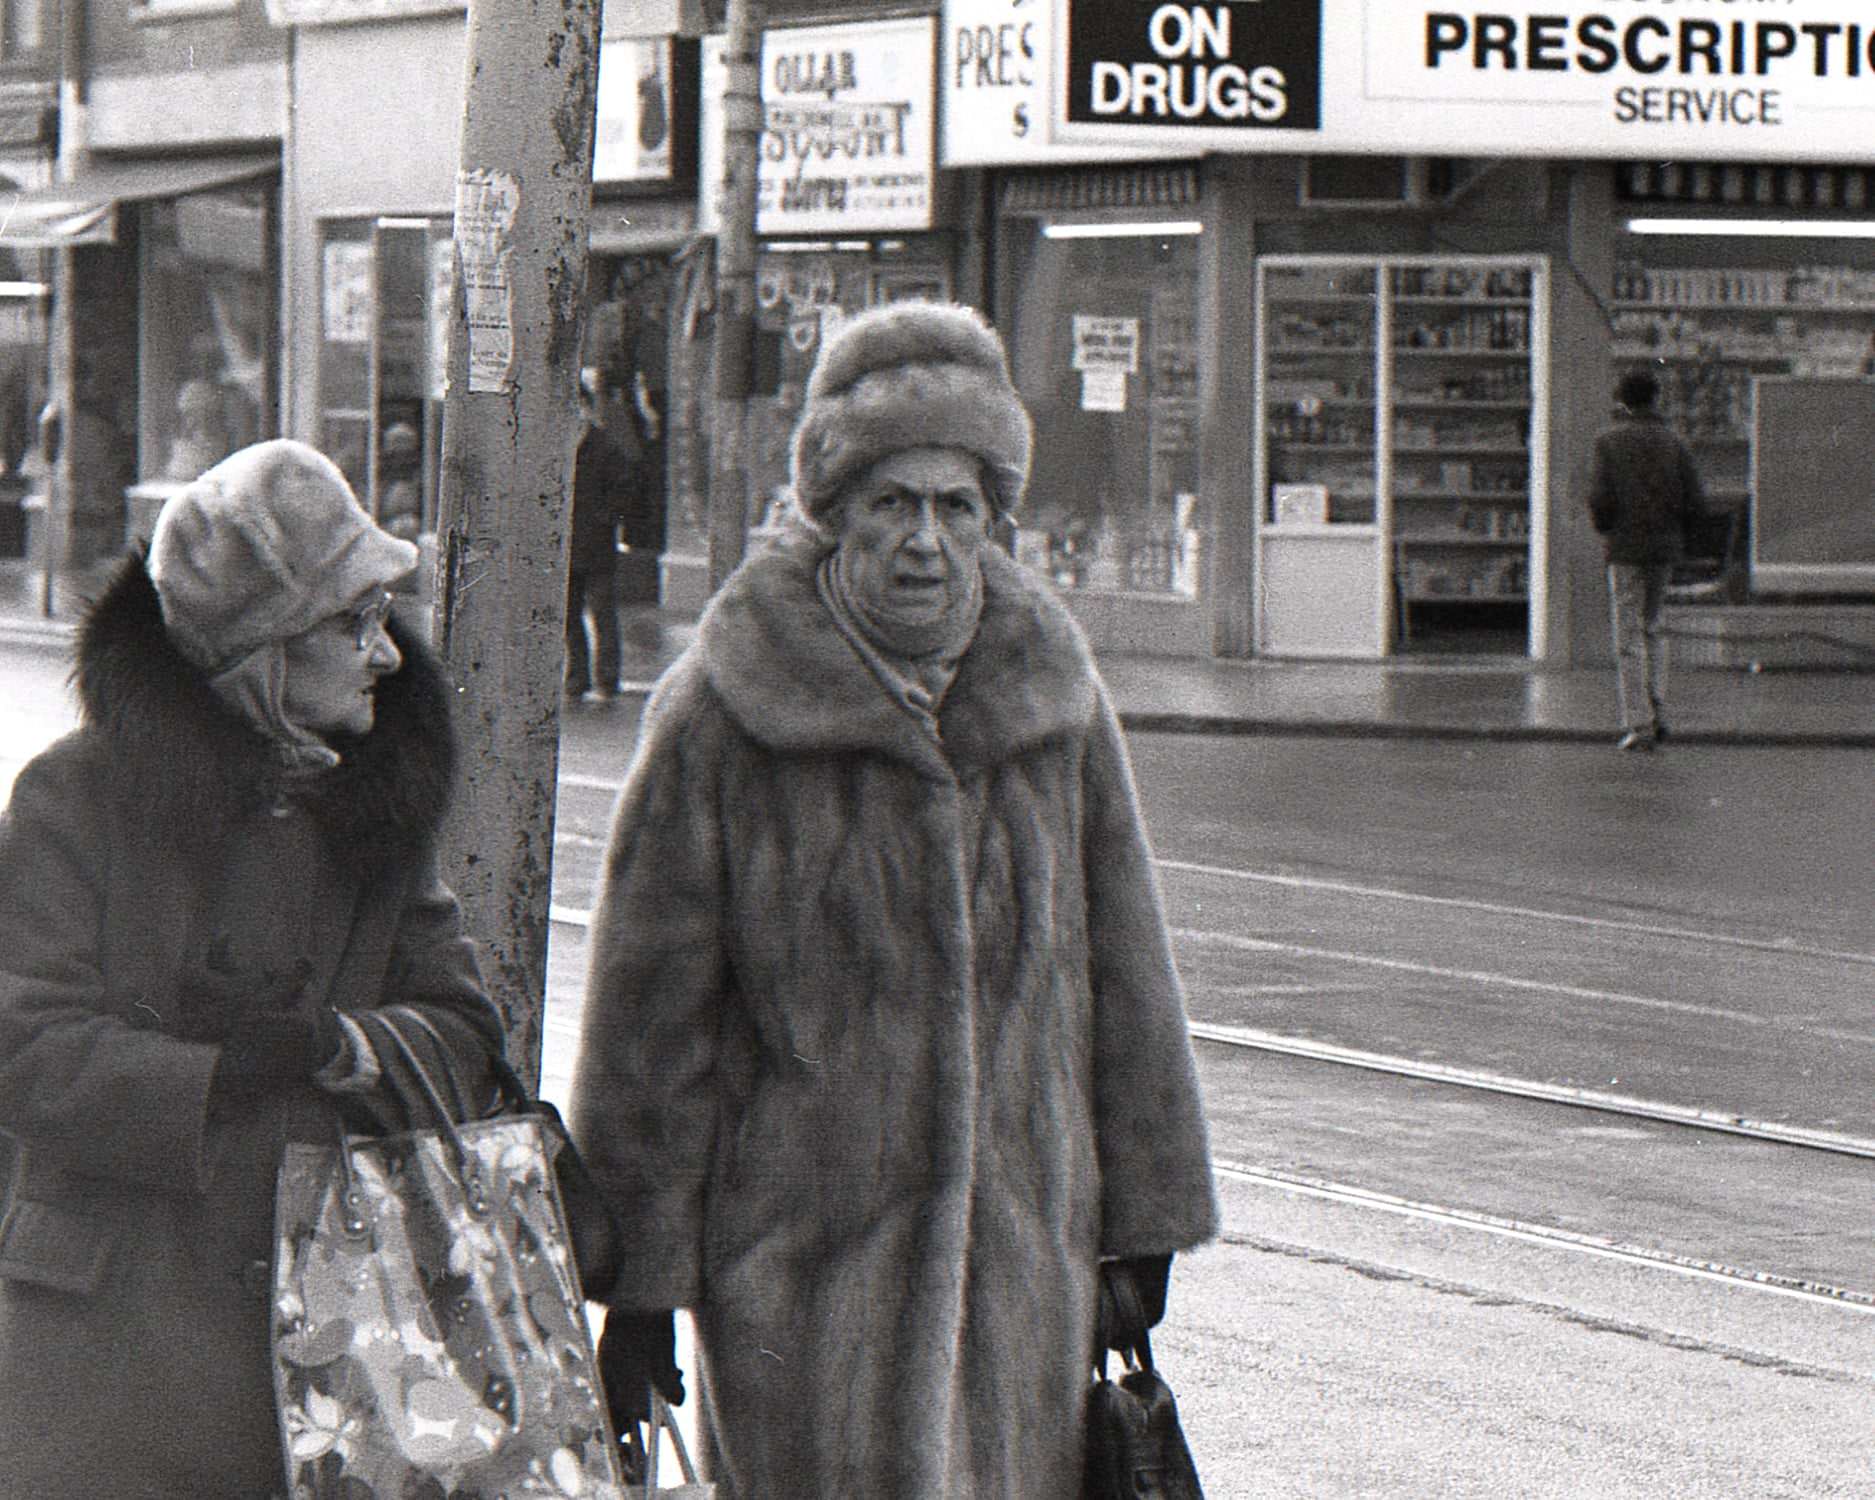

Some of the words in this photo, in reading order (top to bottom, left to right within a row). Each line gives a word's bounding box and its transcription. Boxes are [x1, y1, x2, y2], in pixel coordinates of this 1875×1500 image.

[1150, 4, 1232, 59] ON
[1425, 12, 1875, 77] PRESCRIPTI
[1091, 61, 1288, 121] DRUGS
[1614, 86, 1782, 125] SERVICE
